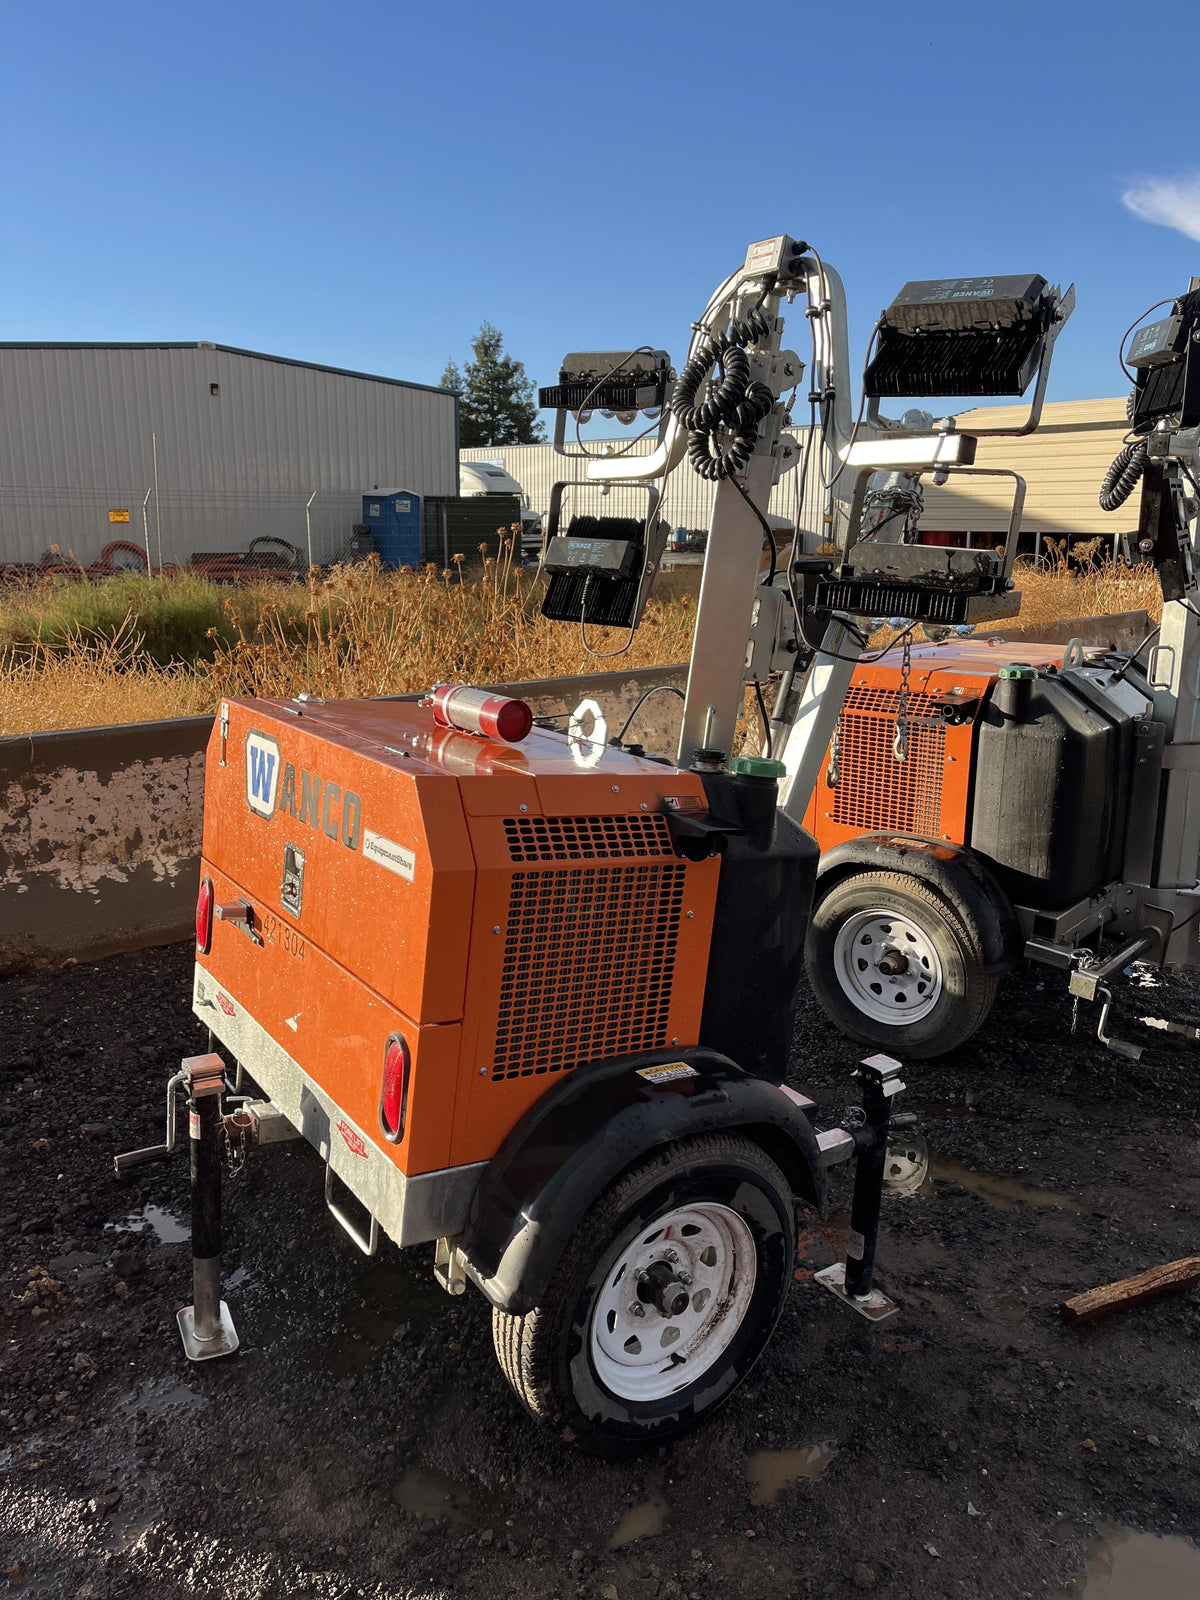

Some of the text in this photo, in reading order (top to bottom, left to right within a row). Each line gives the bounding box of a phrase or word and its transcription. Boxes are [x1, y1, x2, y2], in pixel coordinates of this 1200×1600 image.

[952, 288, 994, 298] WANCO
[247, 738, 362, 851] WANCO
[263, 914, 305, 962] 421304
